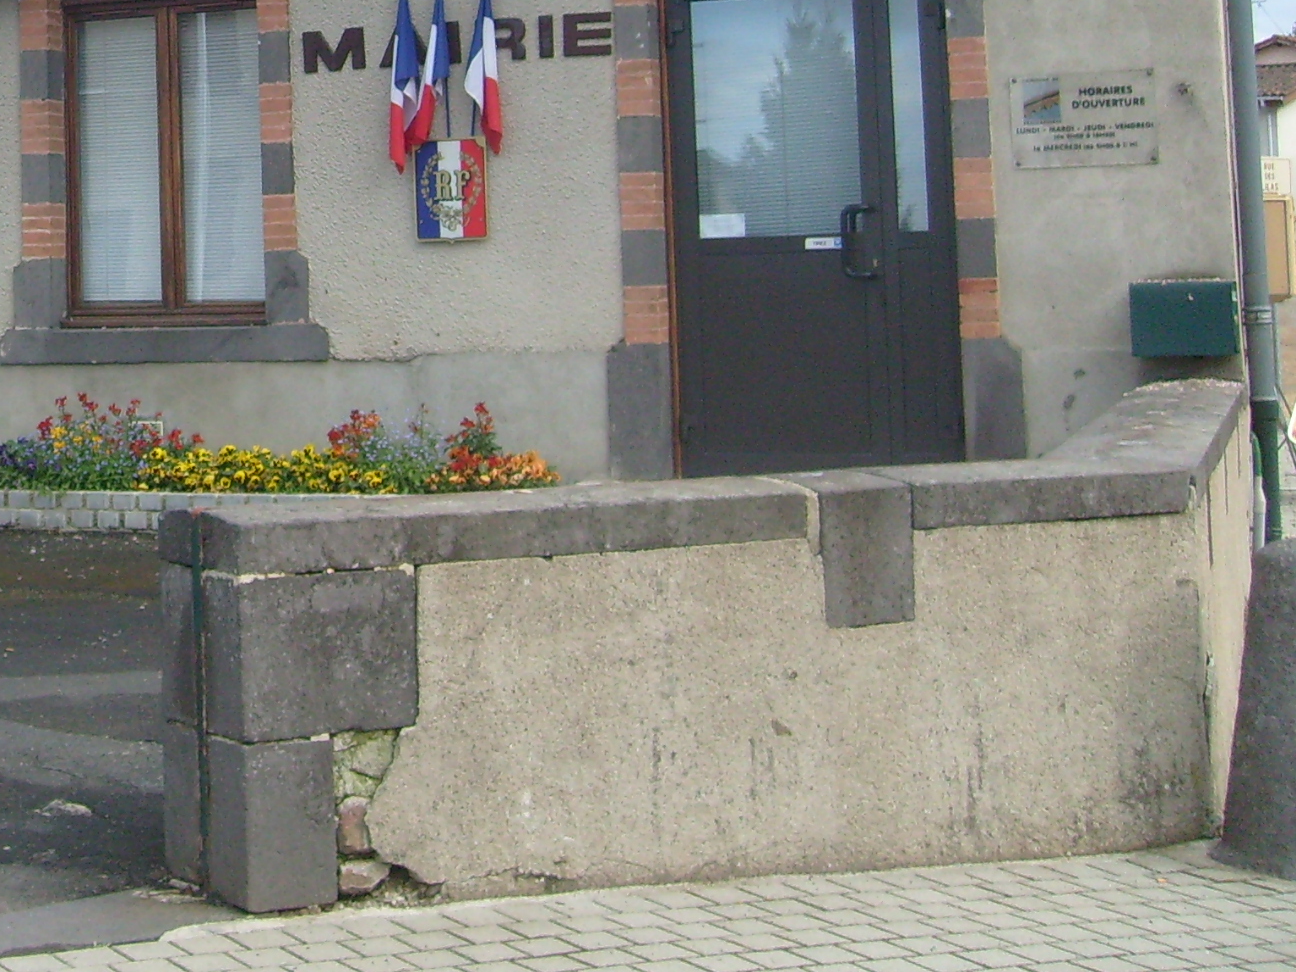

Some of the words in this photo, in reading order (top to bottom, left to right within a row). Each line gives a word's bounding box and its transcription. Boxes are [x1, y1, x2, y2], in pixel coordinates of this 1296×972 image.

[1078, 85, 1133, 96] HORAIRES
[1072, 97, 1146, 109] D'OUVERTURE
[1016, 127, 1040, 135] LUNDI
[1049, 125, 1075, 133] MARDI
[1084, 124, 1106, 132] JEUDI
[1114, 121, 1154, 130] VENDREDI
[1043, 144, 1082, 152] MERCREDI
[433, 170, 471, 202] RF
